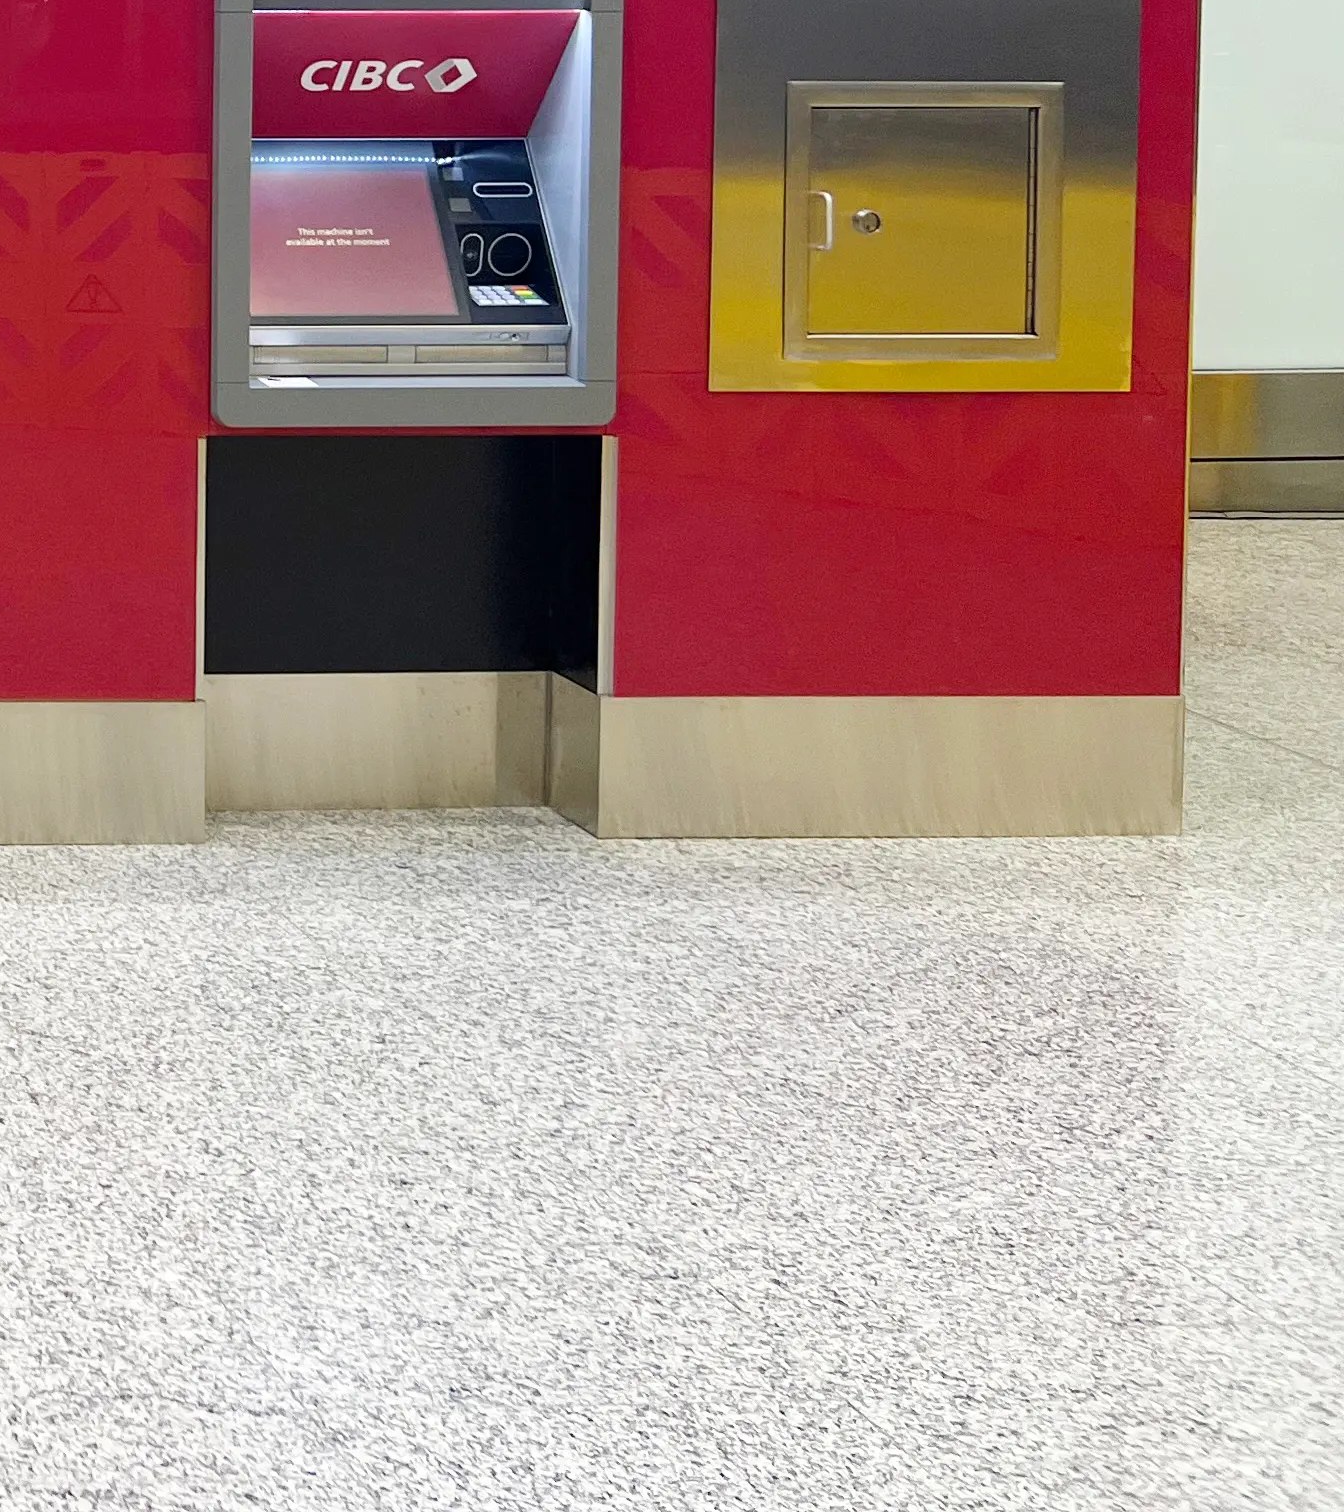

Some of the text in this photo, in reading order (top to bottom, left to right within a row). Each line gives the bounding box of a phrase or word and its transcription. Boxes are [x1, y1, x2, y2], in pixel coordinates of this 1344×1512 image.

[300, 59, 424, 92] CIBC
[297, 227, 316, 236] This
[316, 227, 353, 236] machine
[285, 238, 324, 246] available
[337, 238, 352, 246] the
[353, 238, 390, 246] moment
